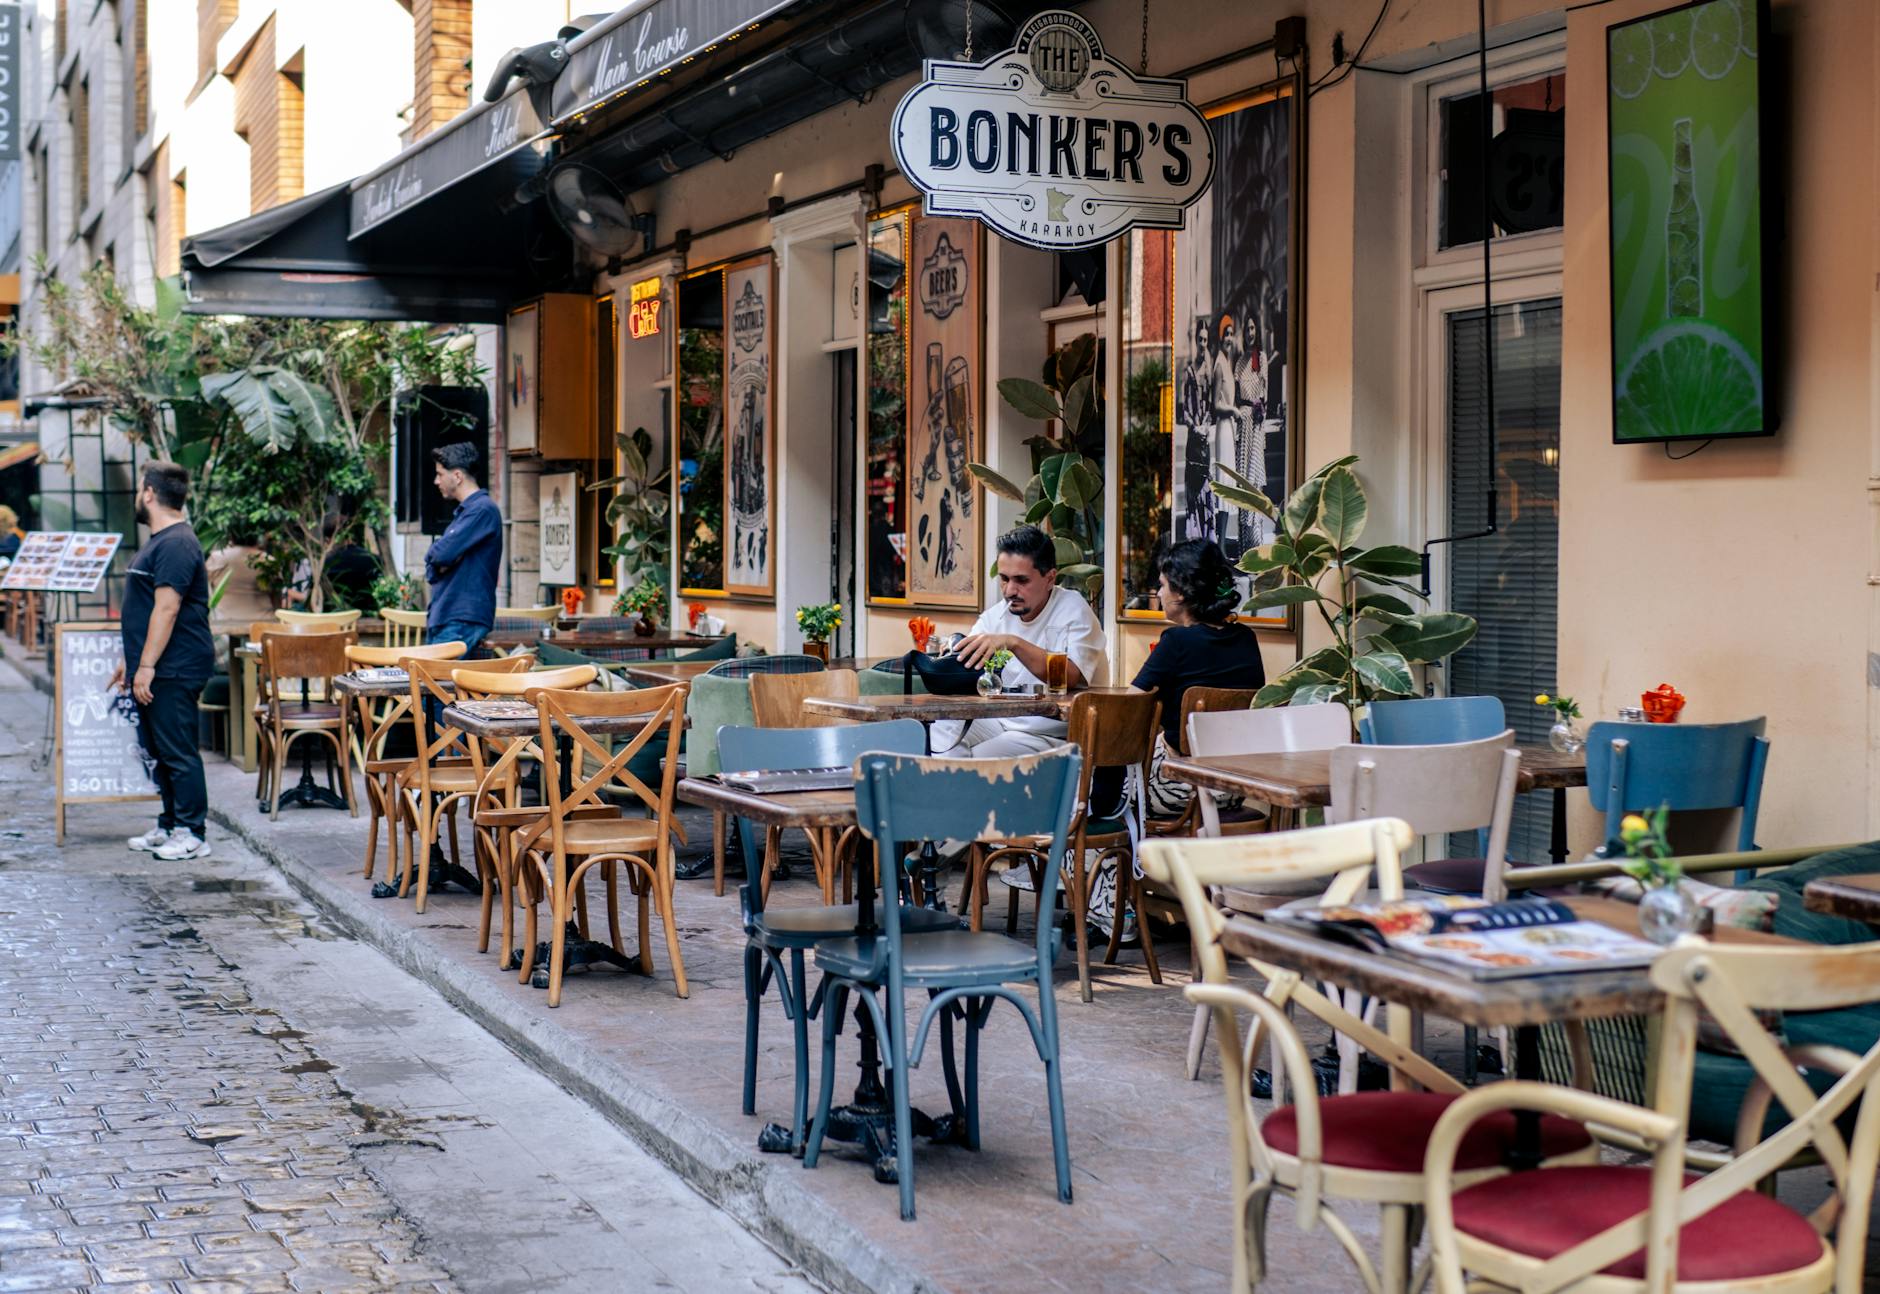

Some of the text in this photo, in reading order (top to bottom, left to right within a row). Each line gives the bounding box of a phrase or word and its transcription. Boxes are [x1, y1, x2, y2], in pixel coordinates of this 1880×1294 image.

[1026, 15, 1084, 35] NEIGHBORHOOD
[588, 12, 688, 98] Main Course
[1039, 46, 1079, 73] THE
[929, 106, 1192, 187] BONKER'S
[929, 266, 958, 298] BEERS
[68, 635, 124, 654] HAPP
[72, 657, 122, 676] HOU
[68, 777, 101, 792] 360
